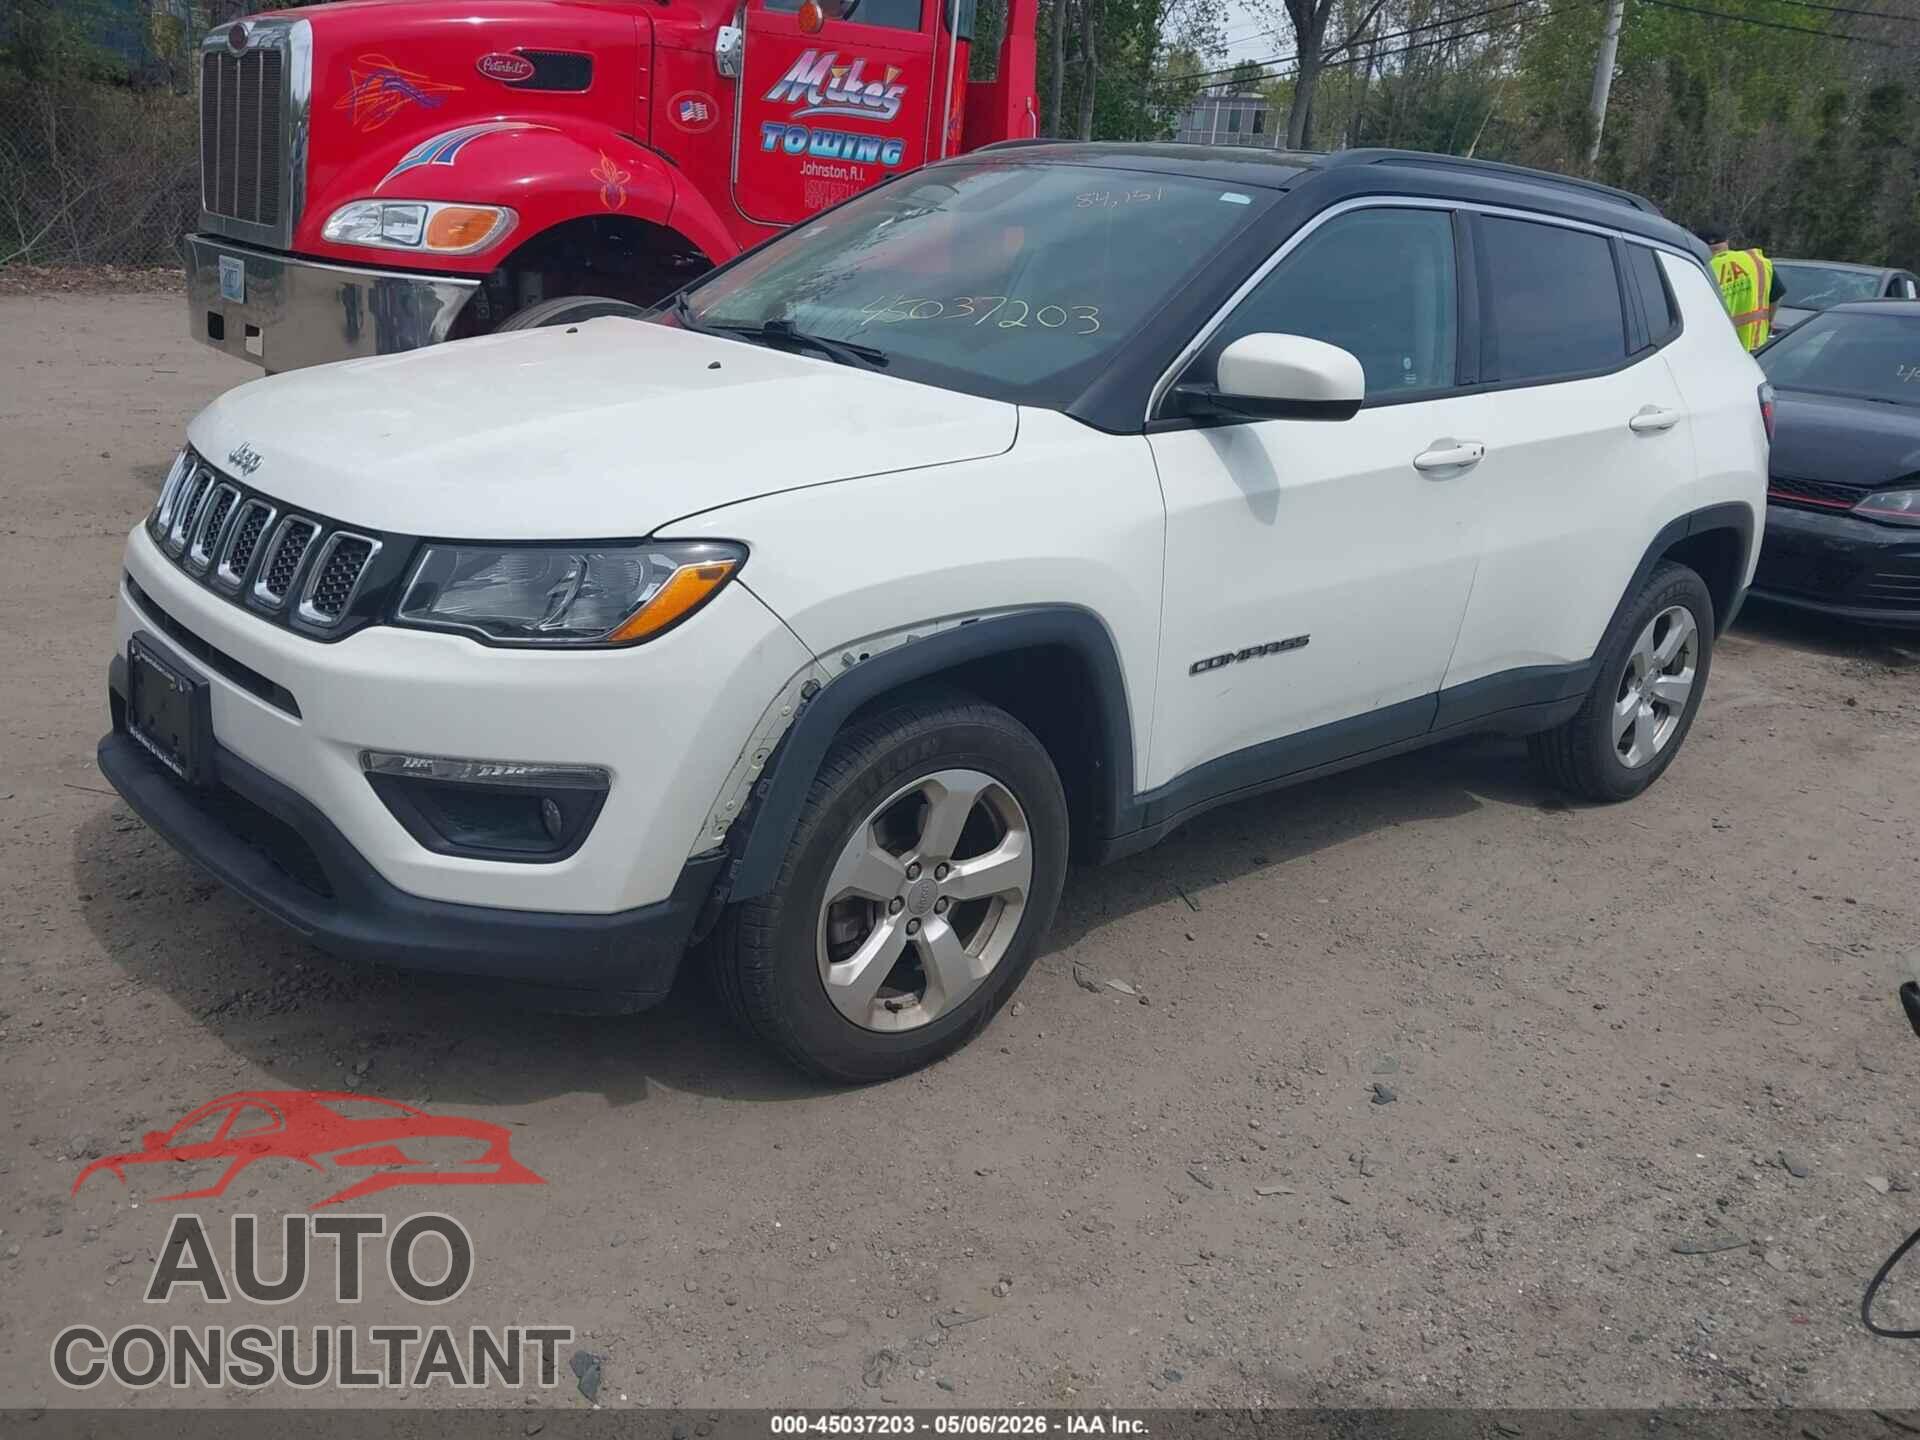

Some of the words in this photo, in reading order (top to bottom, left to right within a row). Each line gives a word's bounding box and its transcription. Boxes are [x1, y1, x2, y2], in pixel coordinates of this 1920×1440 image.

[483, 56, 528, 74] Peterbilt
[761, 48, 907, 120] Mike's
[760, 121, 906, 166] TOWING
[800, 159, 848, 182] Johnston,
[860, 295, 1101, 335] 45037203
[229, 440, 263, 476] Jeep
[1188, 634, 1311, 677] COMPASS
